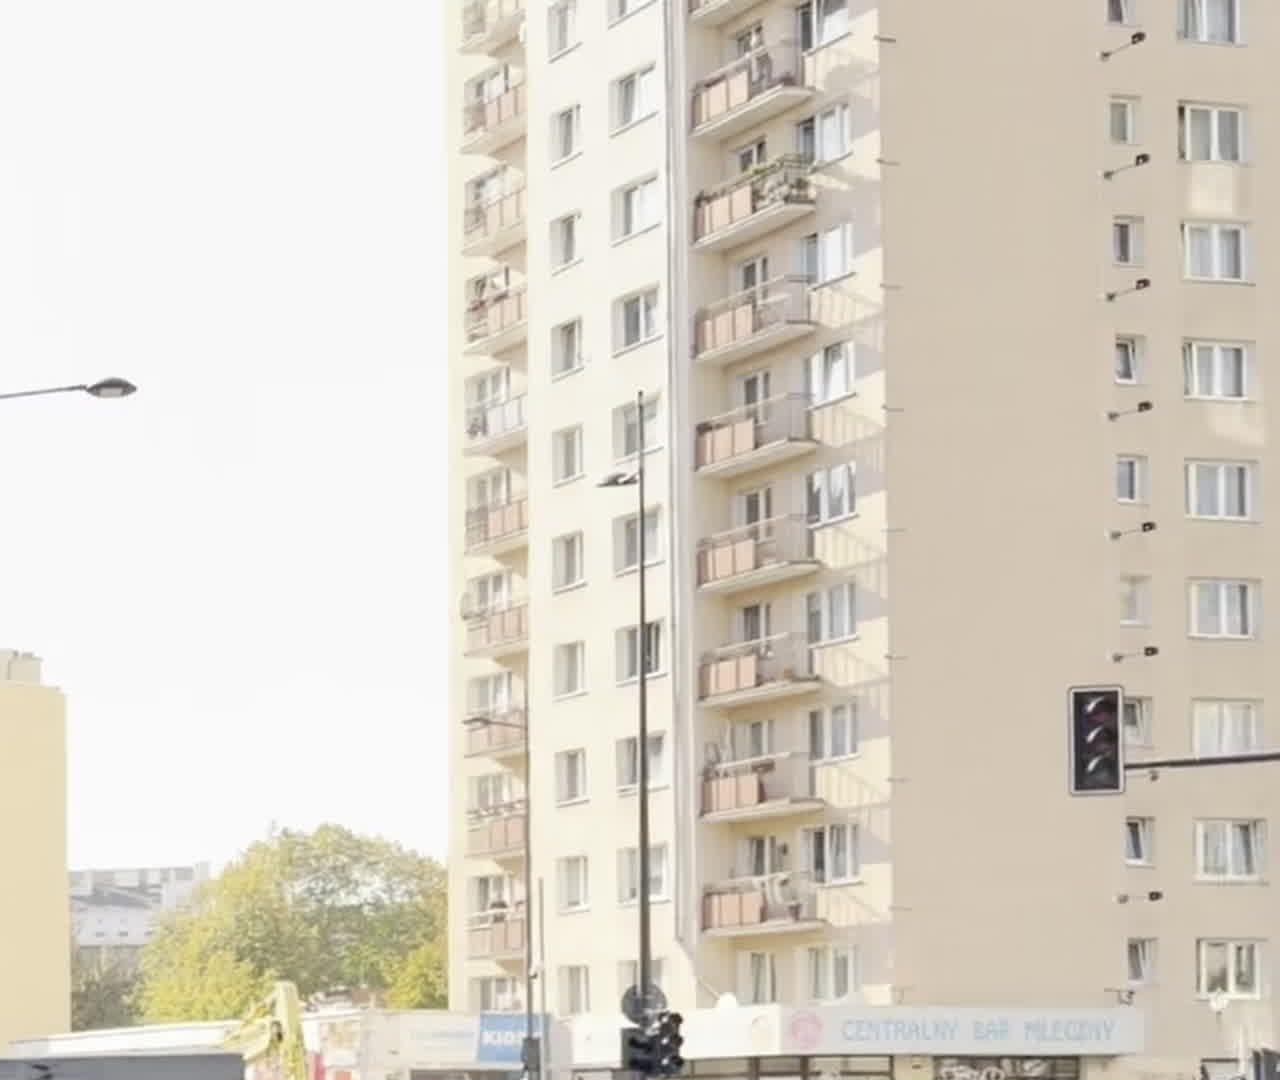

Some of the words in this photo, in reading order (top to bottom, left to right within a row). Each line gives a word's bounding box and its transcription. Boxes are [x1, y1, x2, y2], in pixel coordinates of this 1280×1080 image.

[482, 1030, 543, 1048] KIO
[841, 1018, 960, 1041] CENTRALNY
[972, 1019, 1009, 1041] BAR
